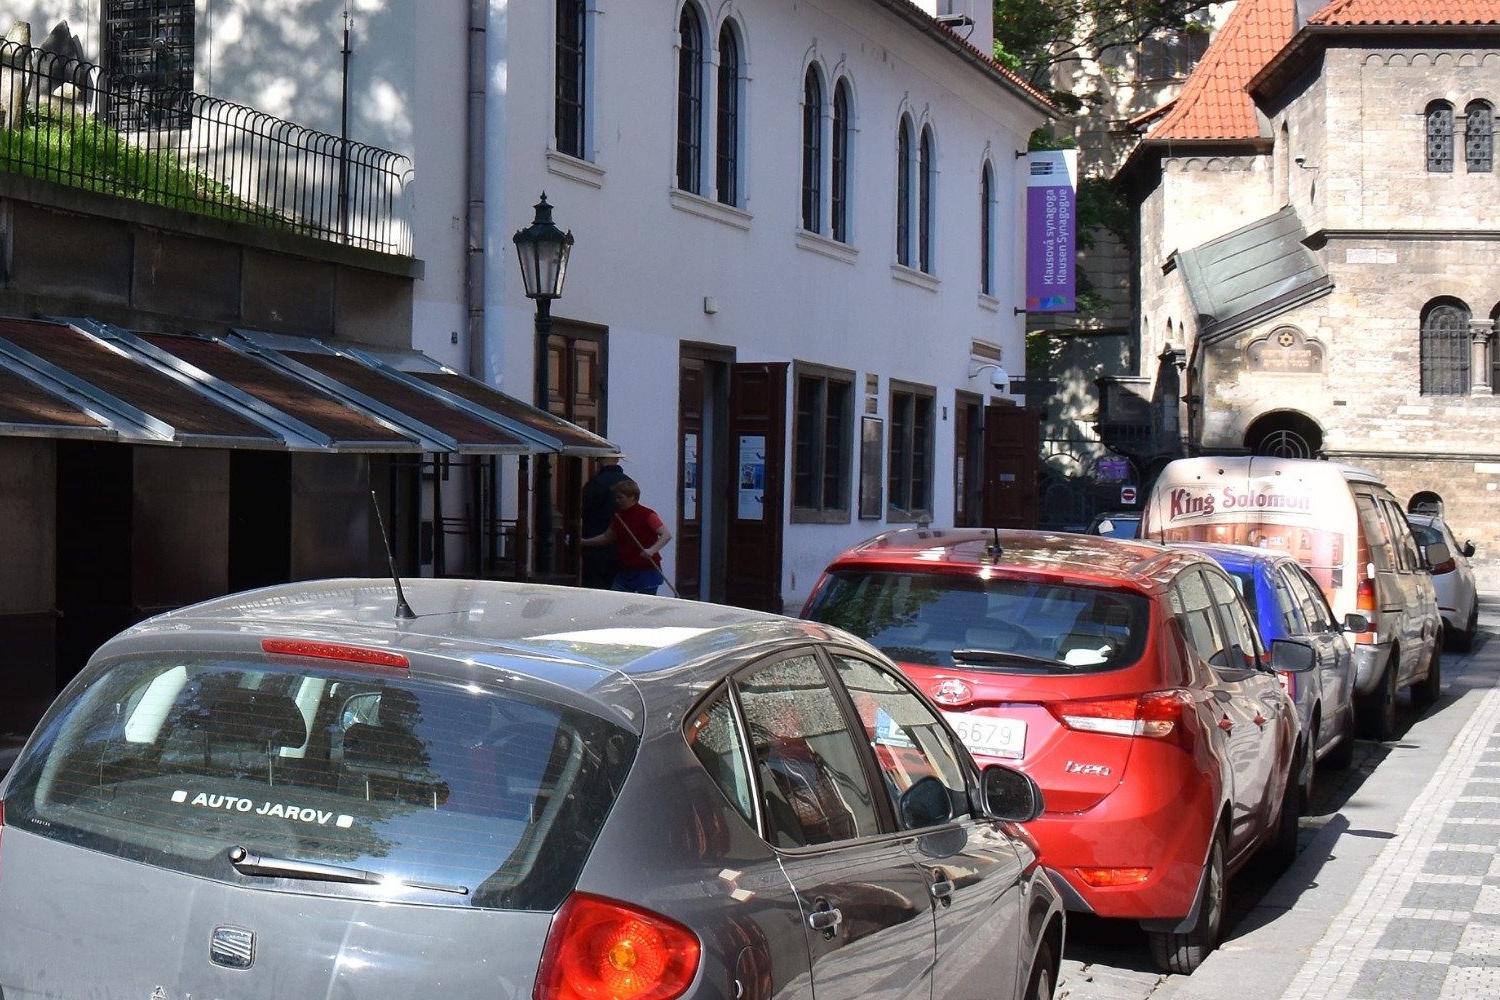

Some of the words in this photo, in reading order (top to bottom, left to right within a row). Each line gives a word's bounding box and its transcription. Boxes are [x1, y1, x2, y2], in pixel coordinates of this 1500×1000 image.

[1046, 189, 1057, 237] synagoga
[1057, 188, 1070, 243] Synagogue
[1044, 240, 1055, 285] Klausová
[1056, 244, 1067, 285] Klausen
[1170, 488, 1215, 520] King
[1222, 487, 1309, 510] Solomon
[957, 721, 1012, 745] 6679
[191, 792, 252, 812] AUTO
[255, 802, 333, 825] JAROV
